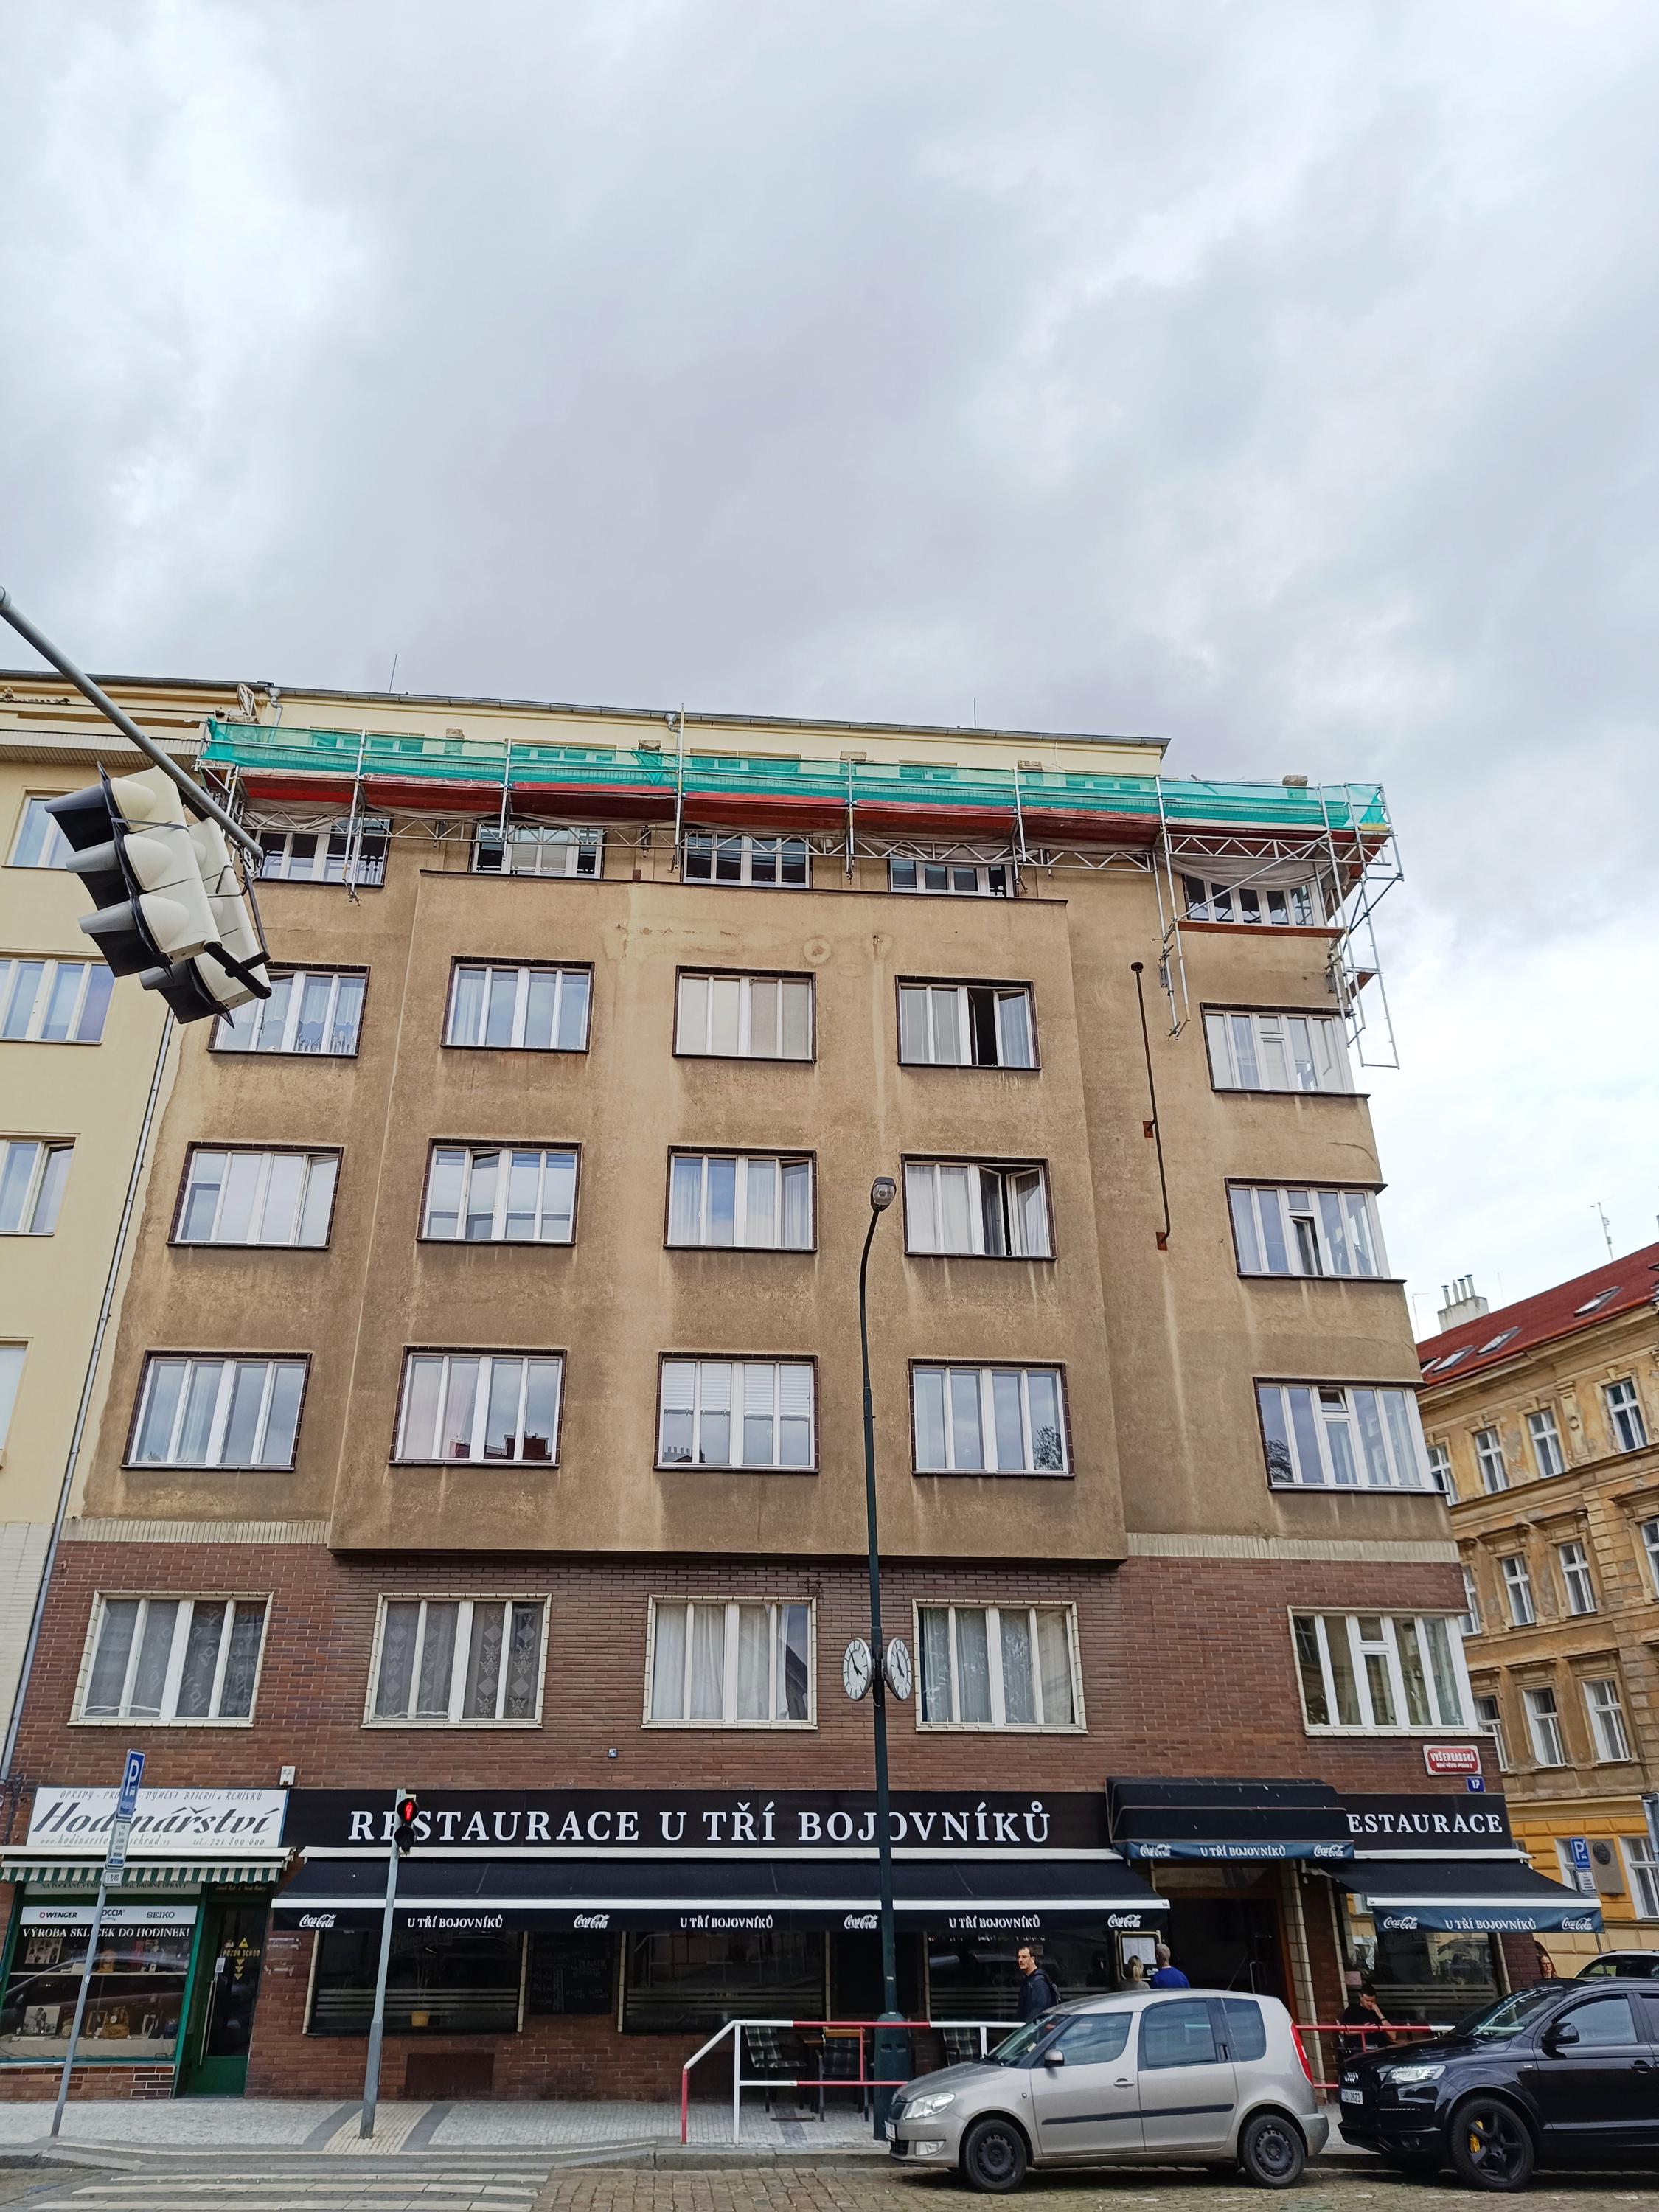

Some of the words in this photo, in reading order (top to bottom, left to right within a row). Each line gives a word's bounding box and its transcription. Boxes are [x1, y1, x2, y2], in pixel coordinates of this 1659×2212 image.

[125, 1759, 139, 1796] P
[1472, 1779, 1481, 1789] 17
[60, 1790, 94, 1801] OPRAVY
[32, 1801, 280, 1833] Hodnářství
[348, 1810, 639, 1842] RESTAURACE
[660, 1811, 686, 1840] U
[703, 1801, 775, 1841] TŘÍ
[798, 1801, 1050, 1843] BOJOVNÍKŮ
[1346, 1813, 1503, 1833] ESTAURACE
[1200, 1846, 1208, 1857] U
[1209, 1844, 1227, 1857] TŘÍ
[1228, 1844, 1286, 1857] BOJOVNÍKŮ
[1574, 1840, 1585, 1860] P
[407, 1918, 415, 1928] U
[417, 1915, 437, 1928] TŘÍ
[439, 1914, 503, 1929] BOJOVNÍKŮ
[680, 1917, 687, 1928] U
[690, 1915, 709, 1929] TŘÍ
[711, 1914, 773, 1929] BOJOVNÍKŮ
[949, 1917, 956, 1929] U
[959, 1915, 978, 1929] TŘÍ
[979, 1914, 1040, 1929] BOJOVNÍKŮ
[1444, 1919, 1453, 1929] U
[1455, 1916, 1475, 1929] TŘÍ
[1476, 1917, 1537, 1930] BOJOVNÍKŮ
[23, 1926, 67, 1938] VÝROBA
[69, 1927, 115, 1938] SKLEK
[118, 1927, 134, 1938] DO
[136, 1927, 190, 1938] HODINEK!
